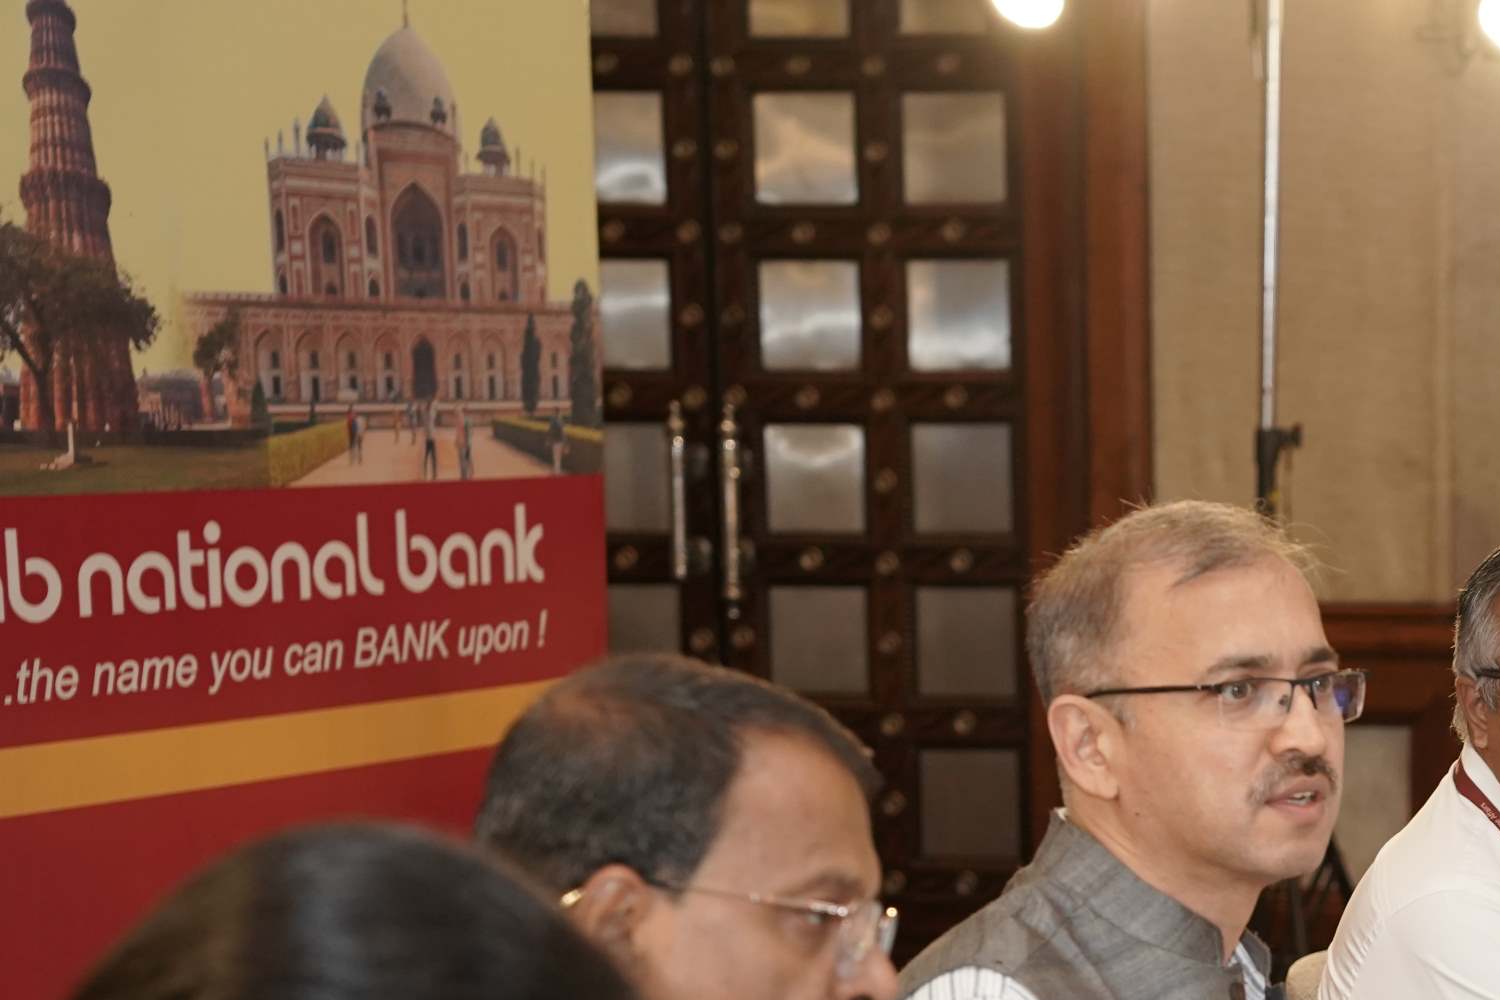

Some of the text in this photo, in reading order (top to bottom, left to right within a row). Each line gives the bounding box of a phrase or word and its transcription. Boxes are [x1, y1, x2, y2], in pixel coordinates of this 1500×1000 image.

[0, 504, 545, 623] b national bank
[92, 655, 198, 696] name
[209, 646, 273, 695] you
[284, 639, 344, 676] can
[354, 619, 450, 668] BANK
[458, 620, 530, 664] upon
[538, 609, 548, 647] !
